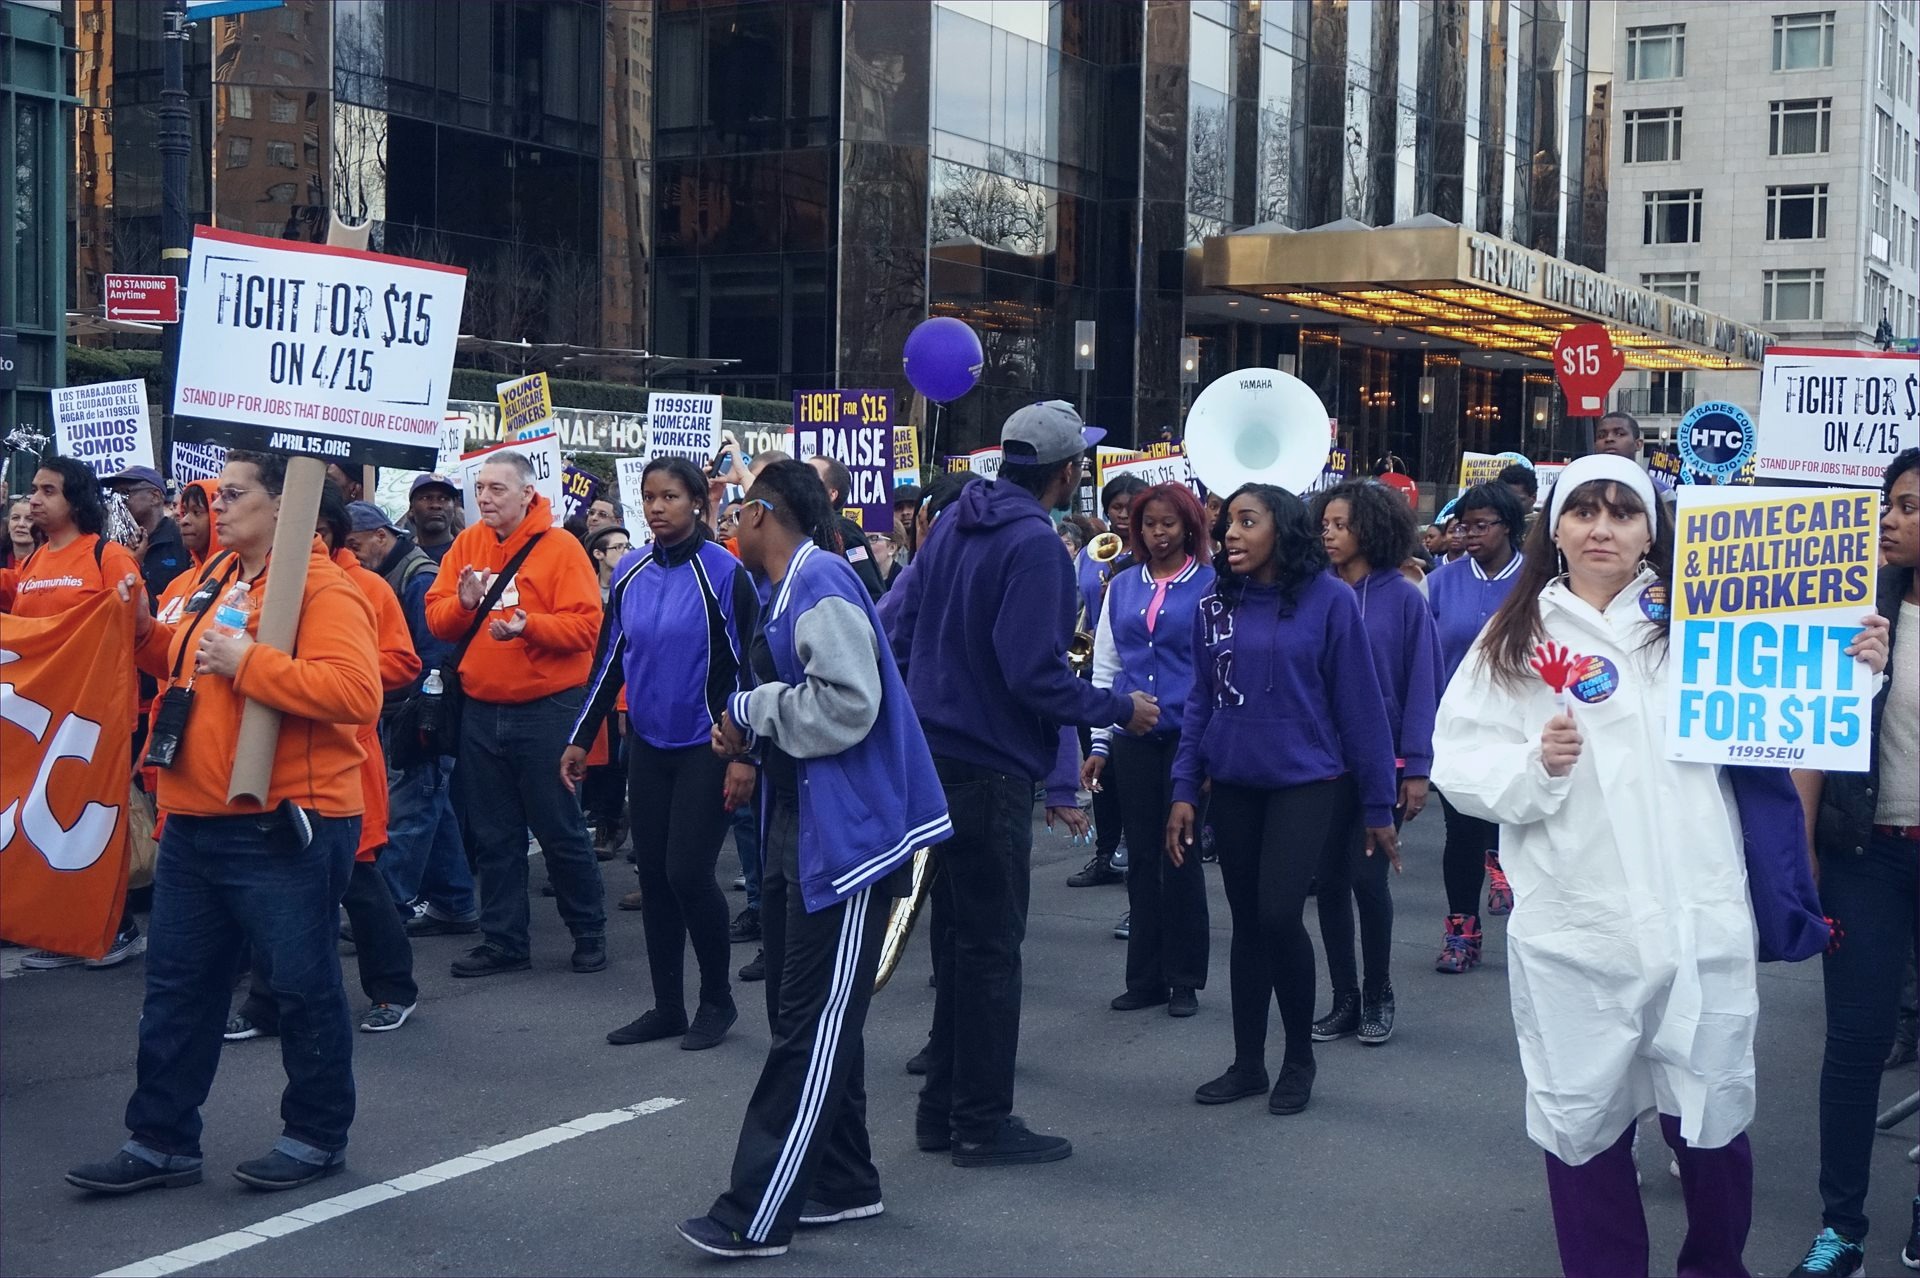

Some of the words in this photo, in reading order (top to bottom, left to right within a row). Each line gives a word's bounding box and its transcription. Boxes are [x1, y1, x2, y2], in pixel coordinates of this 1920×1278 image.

[110, 280, 122, 288] NO
[124, 280, 166, 290] STANDING
[110, 290, 146, 300] Anytime
[1469, 236, 1537, 293] TRUMP
[1544, 262, 1664, 332] INTERNATIONAL
[217, 272, 306, 333] FIGHT
[314, 281, 373, 339] FOR
[381, 282, 433, 348] $15
[270, 341, 305, 386] ON
[311, 344, 375, 392] 4/15
[1562, 344, 1600, 376] $15
[58, 391, 74, 402] LOS
[75, 383, 138, 400] TRABAJADORES
[502, 375, 542, 404] YOUNG
[1240, 380, 1272, 390] YAMAHA
[1786, 375, 1848, 415] FIGHT
[1853, 377, 1897, 416] FOR
[60, 402, 75, 412] DEL
[76, 397, 114, 410] CUIDADO
[115, 396, 127, 405] EN
[128, 394, 139, 404] EL
[60, 412, 85, 423] HOGAR
[86, 410, 96, 420] de
[96, 409, 105, 418] la
[106, 405, 140, 418] 1199SEIU
[182, 387, 217, 407] STAND
[218, 393, 236, 409] UP
[236, 395, 262, 412] FOR
[263, 398, 292, 417] JOBS
[294, 402, 321, 420] THAT
[322, 405, 361, 425] BOOST
[361, 410, 387, 429] OUR
[387, 415, 439, 436] ECONOMY
[504, 388, 544, 419] HEALTHCARE
[655, 398, 713, 414] 1199SEIU
[800, 393, 842, 422] FIGHT
[843, 402, 858, 415] FOR
[861, 393, 887, 425] $15
[67, 418, 138, 441] ¡UNIDOS
[506, 403, 546, 432] WORKERS
[652, 414, 711, 431] HOMECARE
[448, 427, 459, 452] $15
[652, 431, 711, 448] WORKERS
[1680, 421, 1692, 458] HOTEL
[1689, 403, 1735, 420] TRADES
[1735, 412, 1753, 459] COUNCIL
[1691, 428, 1743, 449] HTC
[1824, 421, 1849, 453] ON
[1853, 422, 1900, 455] 4/15
[72, 436, 136, 457] SOMOS
[269, 431, 351, 457] APRIL15.ORG
[802, 442, 815, 455] AND
[822, 428, 886, 467] RAISE
[1148, 442, 1171, 458] FIGHT
[1331, 450, 1346, 471] $15
[1690, 459, 1738, 473] AFL-CIO
[1760, 457, 1788, 470] STAND
[1788, 460, 1801, 471] UP
[1802, 460, 1819, 473] FOR
[1820, 462, 1841, 475] JOBS
[1842, 464, 1861, 476] THAT
[1862, 466, 1888, 478] BOOS
[569, 472, 592, 498] $15
[1687, 496, 1871, 544] HOMECARE
[1684, 550, 1702, 578] &
[1707, 532, 1870, 576] HEALTHCARE
[24, 576, 83, 590] Communities
[1684, 565, 1868, 616] WORKERS
[1682, 620, 1867, 691] FIGHT
[1678, 690, 1767, 742] FOR
[1778, 694, 1860, 748] $15
[1728, 744, 1805, 760] 1199SEIU
